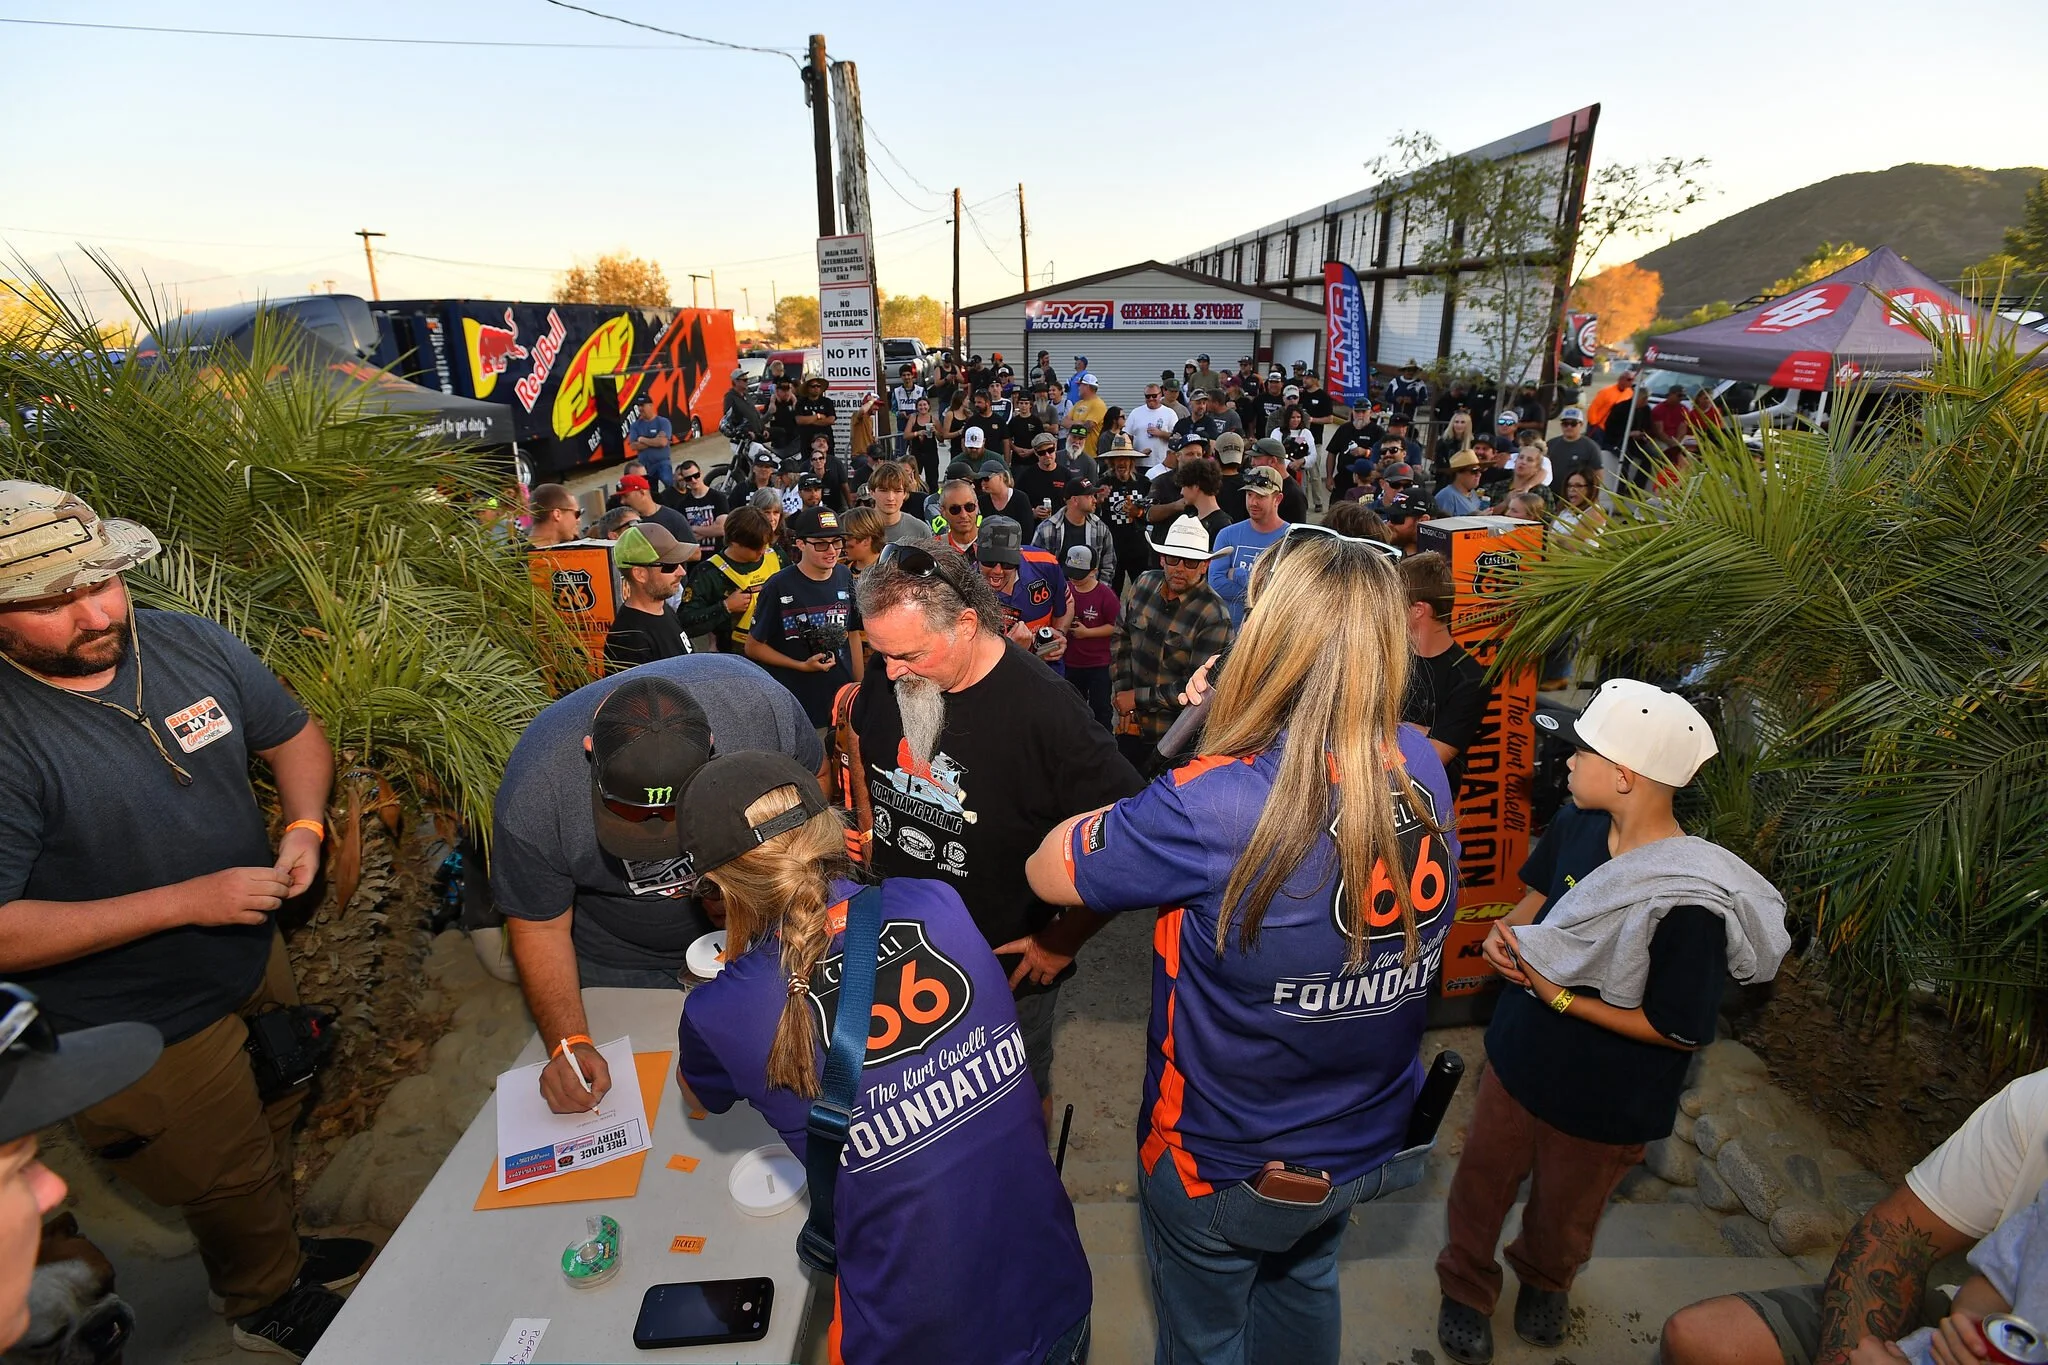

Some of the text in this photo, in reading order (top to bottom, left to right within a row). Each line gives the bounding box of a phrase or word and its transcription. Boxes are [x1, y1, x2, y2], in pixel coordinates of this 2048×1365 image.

[824, 309, 868, 318] SPECTATORS
[840, 300, 850, 308] NO
[1120, 302, 1190, 320] GENERAL
[1193, 303, 1243, 320] STORE
[828, 319, 864, 328] ON TRACK
[1352, 285, 1361, 388] MOTORSPORTS
[514, 308, 567, 414] Red Bull
[827, 348, 868, 359] NO PIT
[828, 366, 871, 377] RIDING
[558, 585, 588, 608] 66
[1034, 586, 1049, 603] 66
[168, 700, 216, 727] BIG BEAR
[187, 711, 214, 732] MX
[1503, 695, 1530, 833] The Kurt Caselli
[870, 780, 963, 835] KORN DAWG RACING
[1364, 834, 1445, 927] 66
[866, 1026, 988, 1110] The Kurt Caselli
[598, 1129, 626, 1145] ENTRY
[580, 1138, 628, 1160] FREE RACE
[674, 1239, 696, 1248] TICKET
[518, 1330, 527, 1344] ON
